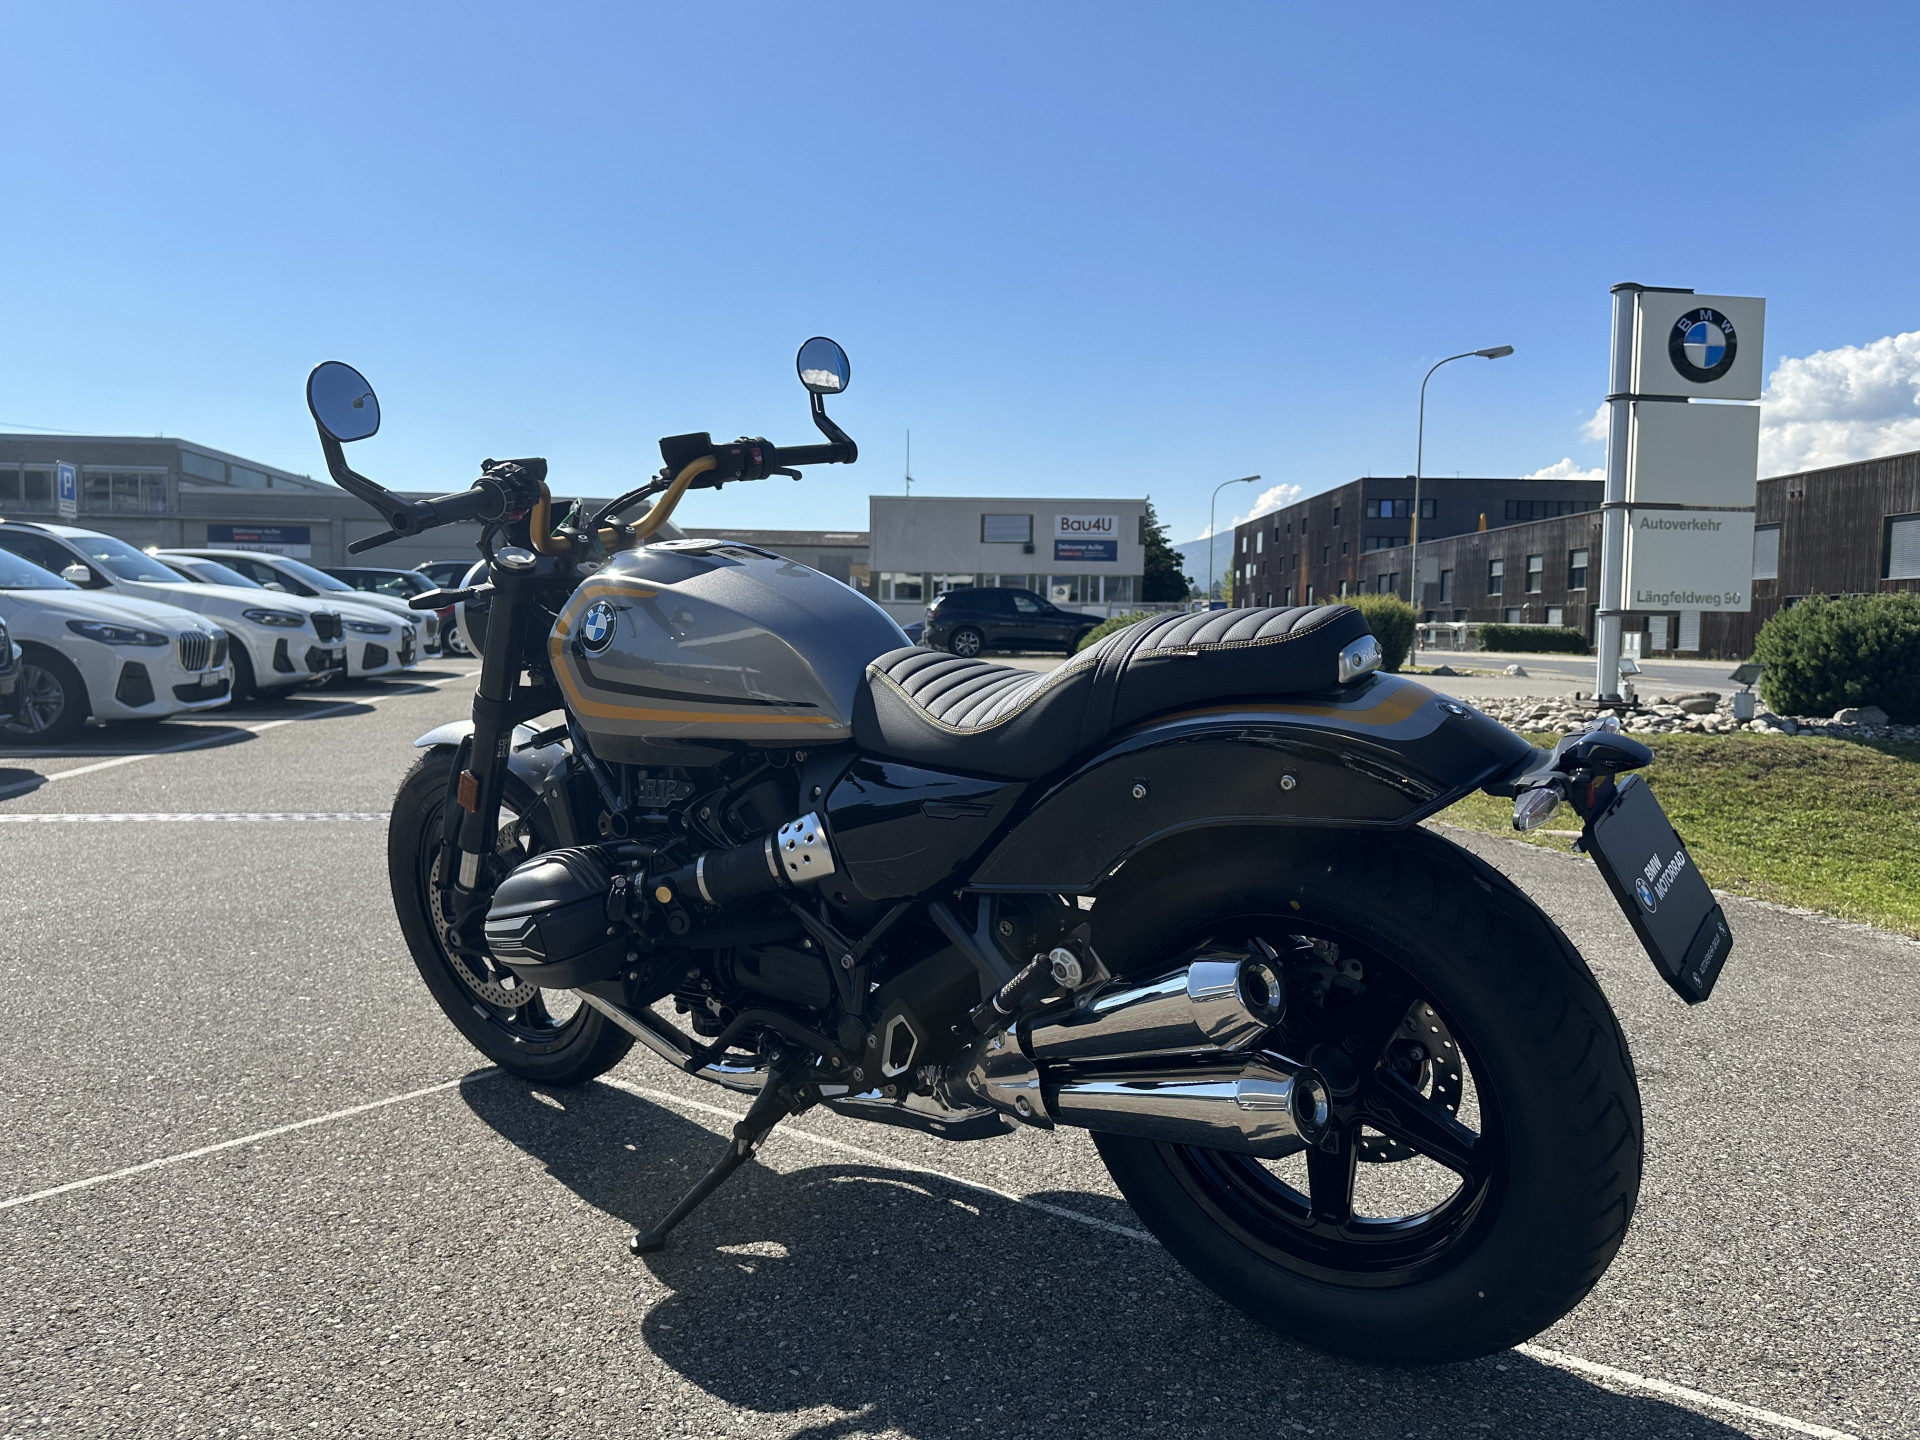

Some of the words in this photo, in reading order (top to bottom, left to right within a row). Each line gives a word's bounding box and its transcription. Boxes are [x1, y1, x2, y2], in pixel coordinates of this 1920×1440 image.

[1677, 309, 1734, 334] BMW
[64, 471, 72, 496] P
[1061, 517, 1112, 531] Bau4U
[1640, 517, 1722, 531] Autoverkehr
[1637, 590, 1721, 606] Längfeldweg
[1724, 592, 1741, 605] 90
[587, 604, 614, 622] BMW
[1643, 853, 1662, 883] BMW
[1654, 850, 1686, 901] MOTORRAD
